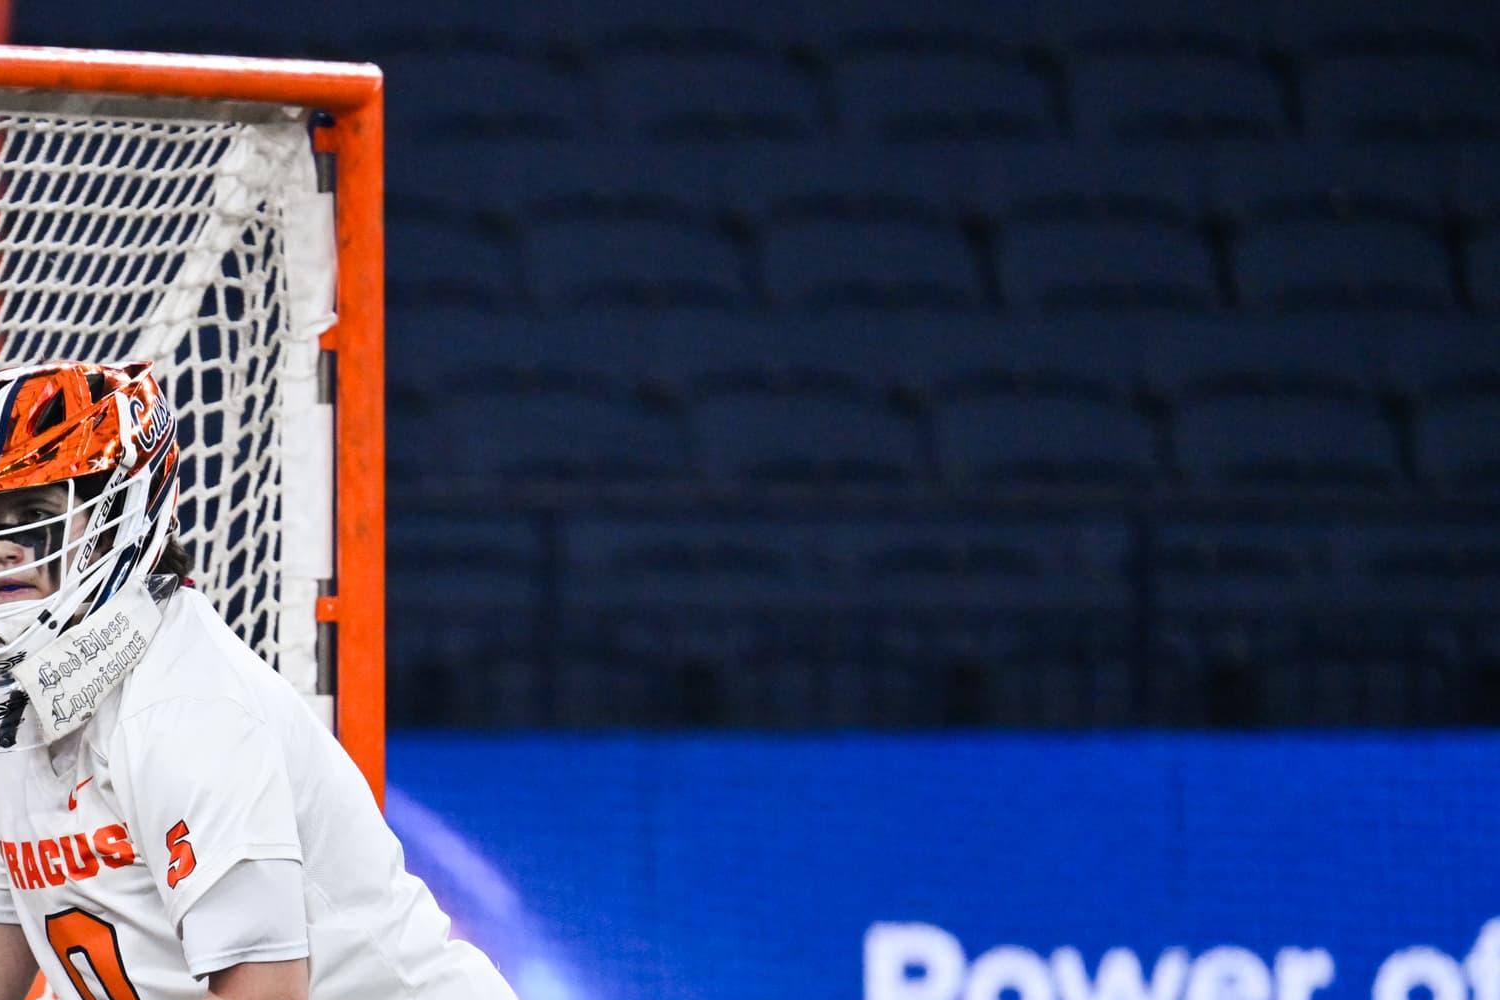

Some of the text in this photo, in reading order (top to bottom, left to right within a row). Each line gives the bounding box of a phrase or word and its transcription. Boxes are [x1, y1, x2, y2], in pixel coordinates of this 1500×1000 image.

[38, 611, 130, 696] God Bless
[165, 819, 197, 890] 5
